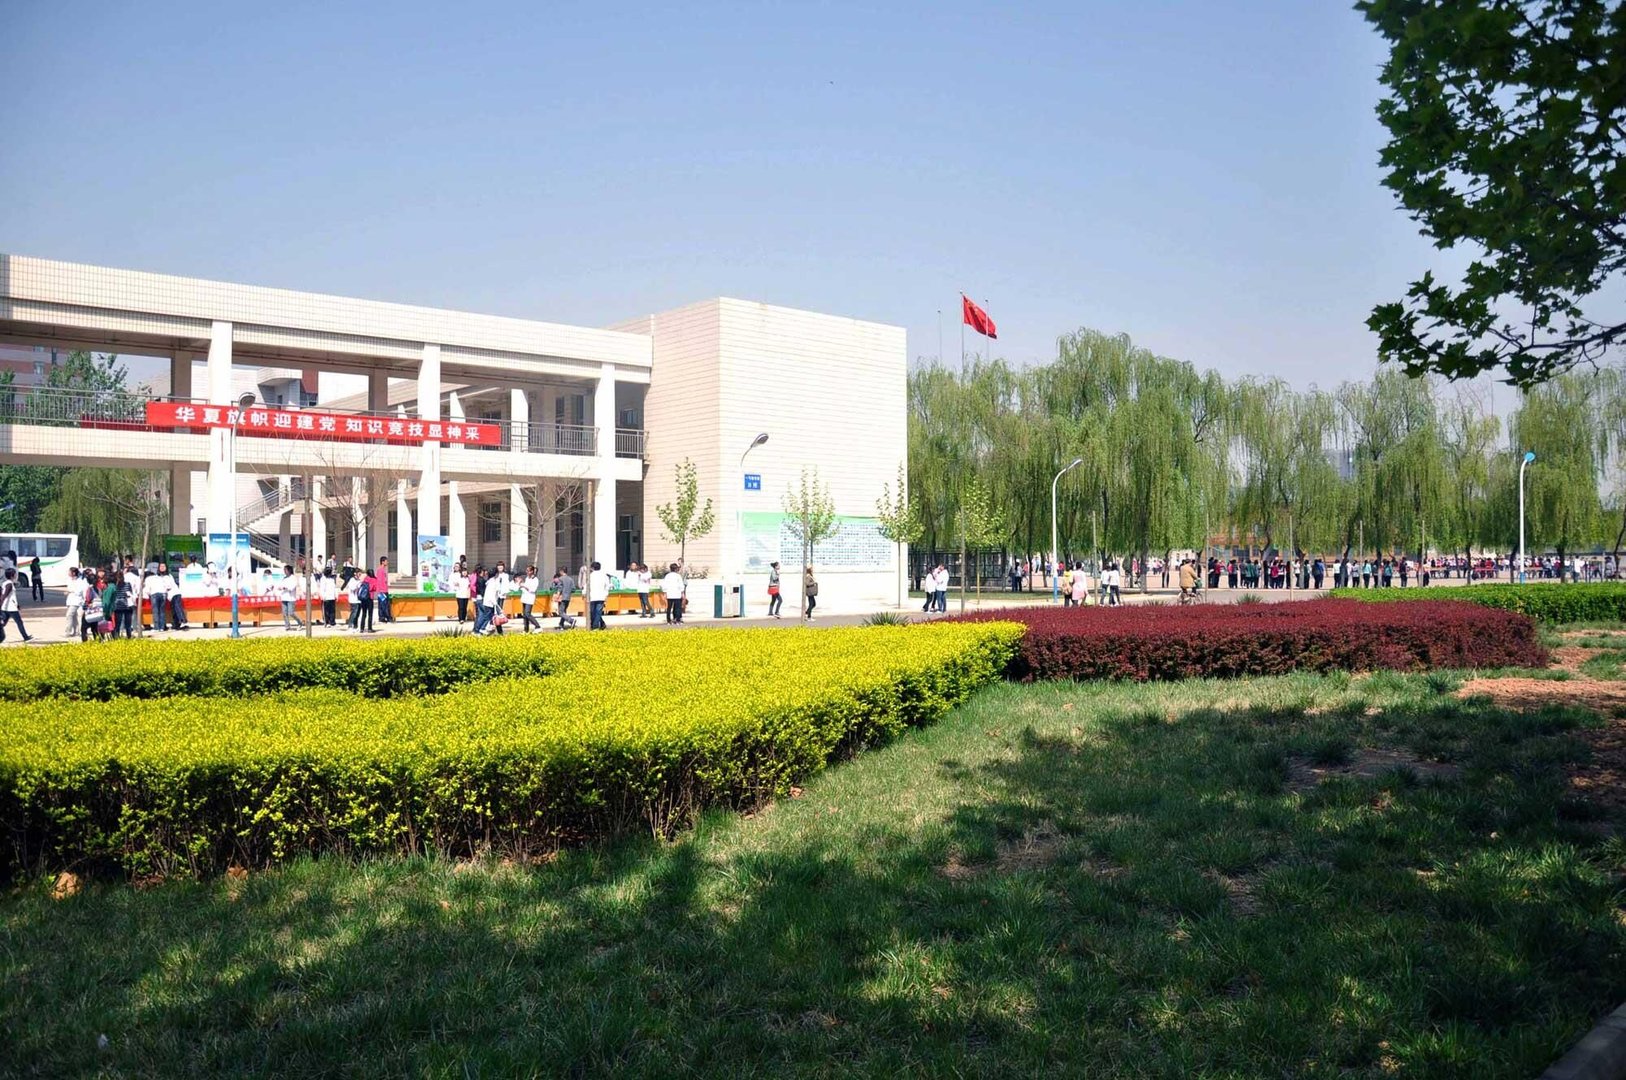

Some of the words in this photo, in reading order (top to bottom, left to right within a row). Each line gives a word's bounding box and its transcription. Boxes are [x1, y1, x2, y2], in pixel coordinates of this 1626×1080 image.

[175, 406, 336, 431] 华夏旗帜迎建党
[345, 418, 480, 440] 知识竞技显神采
